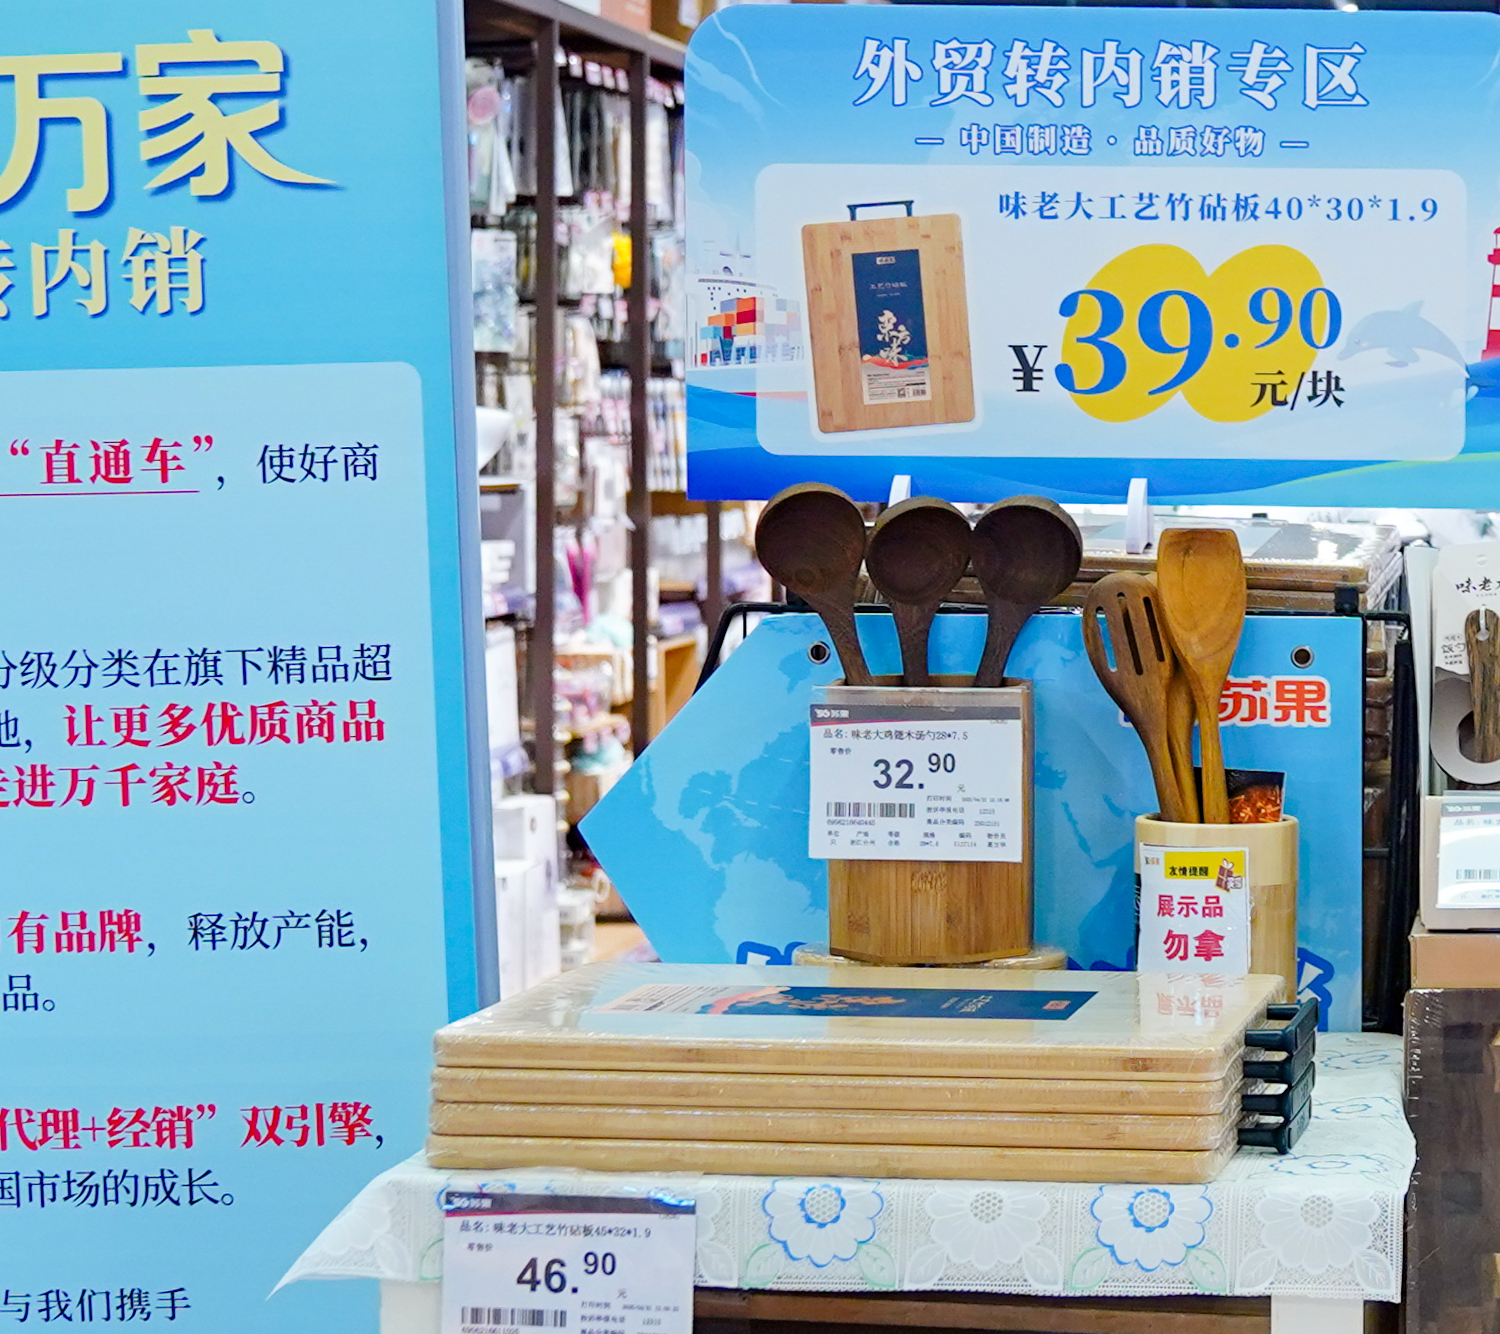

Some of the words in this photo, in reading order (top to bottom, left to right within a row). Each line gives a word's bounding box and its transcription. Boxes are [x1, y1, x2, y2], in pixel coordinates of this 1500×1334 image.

[852, 37, 1369, 111] 外贸转内销专区
[1012, 343, 1046, 393] ¥
[1056, 286, 1344, 396] 39.90
[1249, 368, 1346, 410] 元/块
[1169, 866, 1209, 876] 友情提醒
[1157, 894, 1224, 918] 展示品
[1163, 929, 1226, 962] 勿拿
